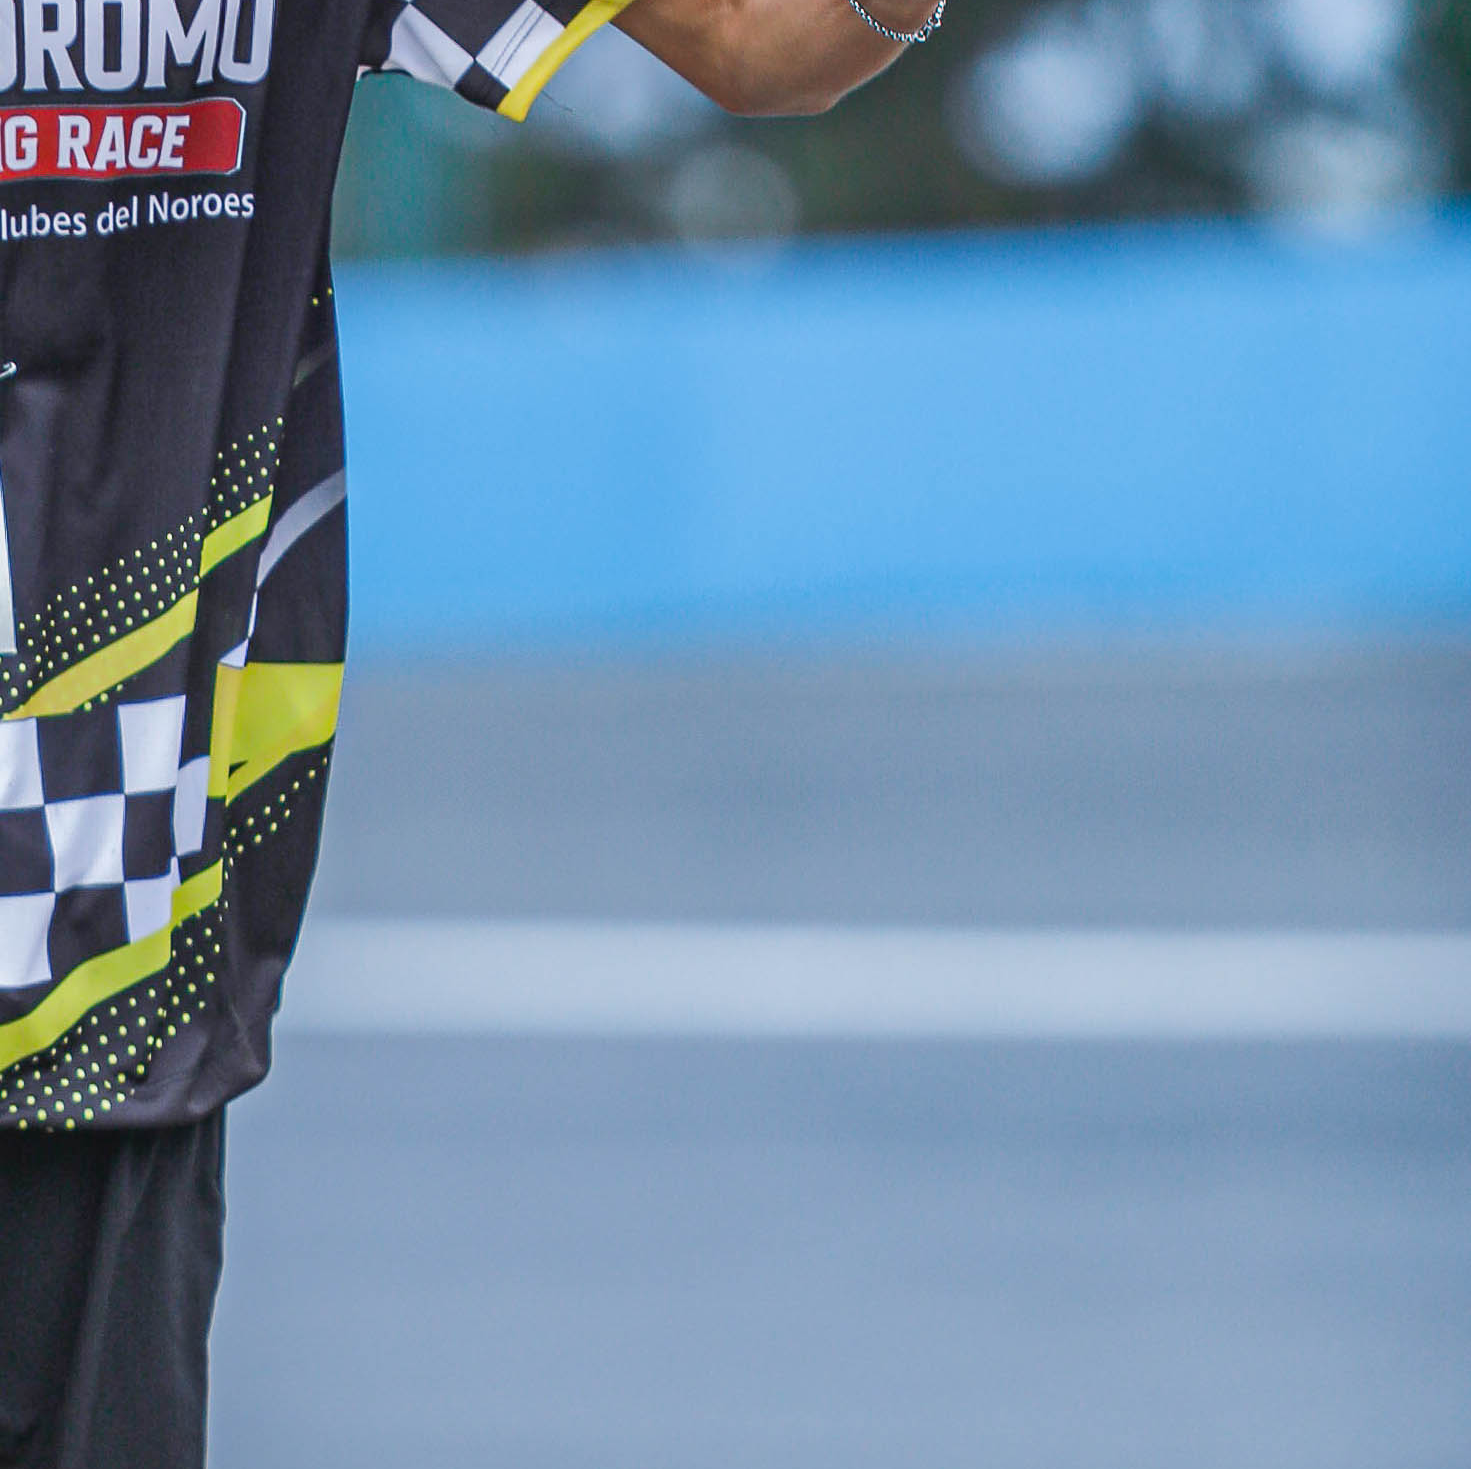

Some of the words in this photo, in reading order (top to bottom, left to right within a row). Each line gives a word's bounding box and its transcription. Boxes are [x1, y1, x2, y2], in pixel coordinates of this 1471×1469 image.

[57, 114, 191, 171] RACE
[96, 195, 138, 235] del
[148, 191, 255, 224] Noroes
